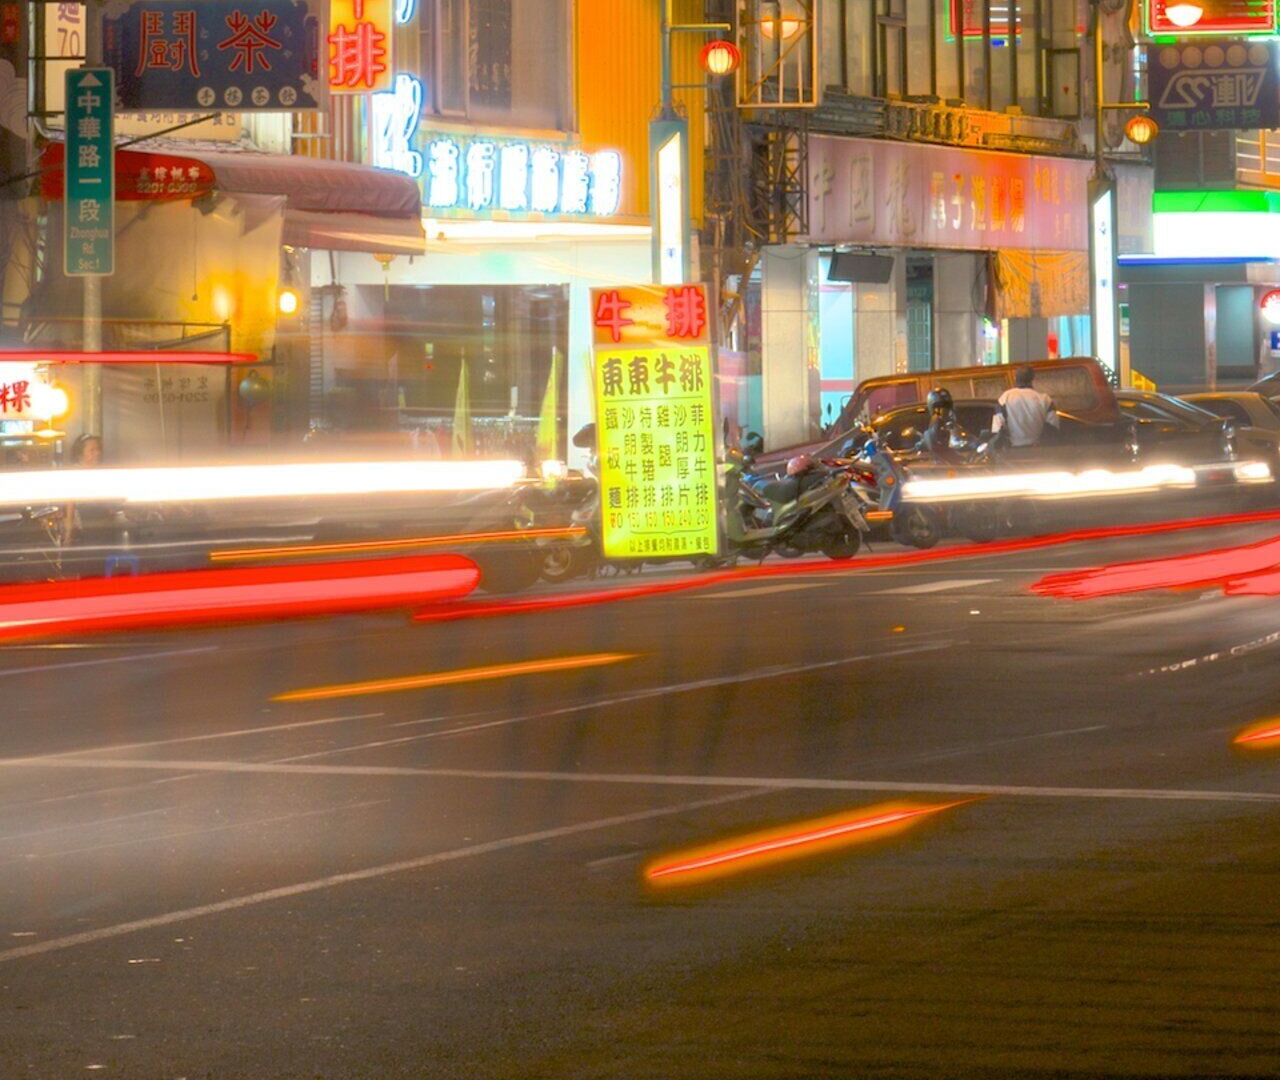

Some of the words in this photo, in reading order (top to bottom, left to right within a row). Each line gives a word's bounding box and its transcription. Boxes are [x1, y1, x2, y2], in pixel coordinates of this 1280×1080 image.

[76, 91, 102, 222] 中華路一段
[594, 287, 705, 342] 牛排
[602, 353, 704, 396] 東東牛排
[622, 406, 640, 509] 沙朗牛排
[673, 403, 691, 506] 沙朗厚片
[690, 402, 709, 506] 菲力牛排
